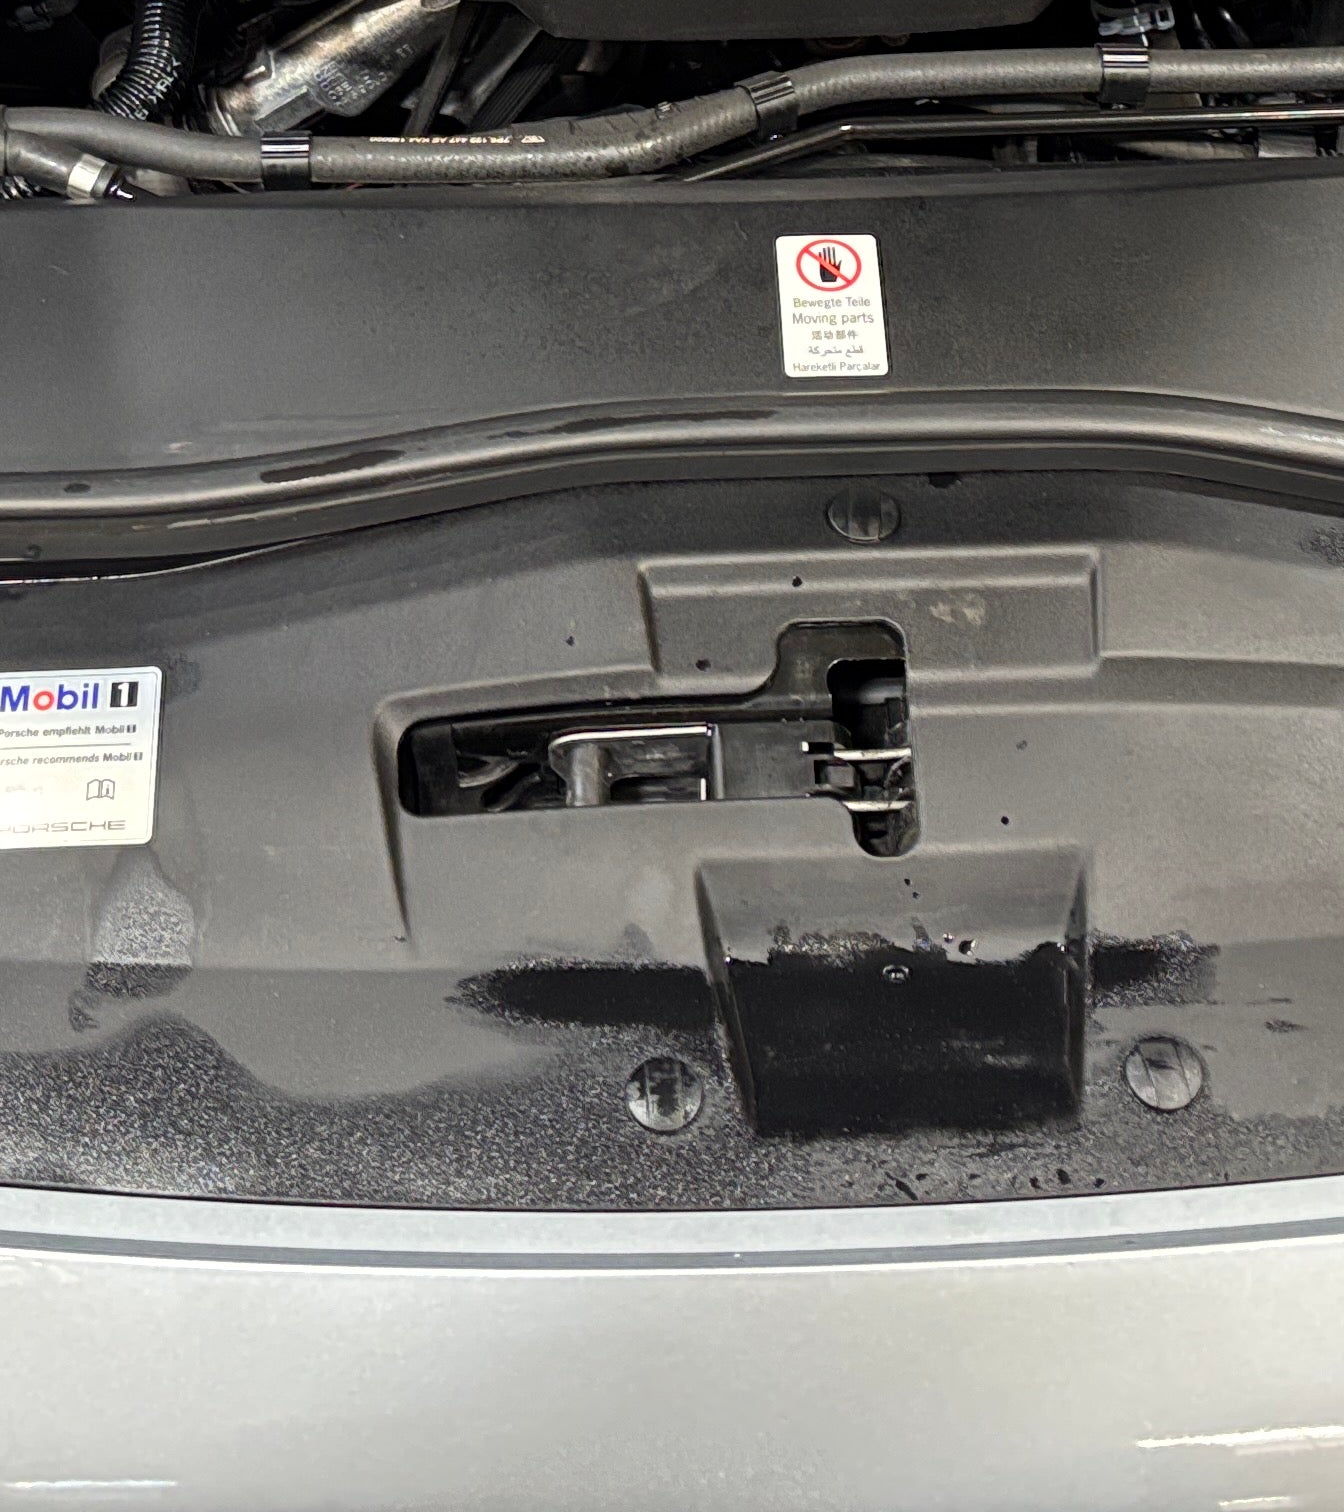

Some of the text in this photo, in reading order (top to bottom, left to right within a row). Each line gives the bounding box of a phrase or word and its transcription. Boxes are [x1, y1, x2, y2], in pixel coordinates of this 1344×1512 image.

[792, 296, 871, 309] Bewegte Teile
[792, 312, 875, 326] Moving parts
[792, 361, 881, 373] Hareketli Parçalar
[0, 682, 100, 712] Mobil
[42, 726, 91, 737] empfiehlt
[94, 724, 125, 735] Mobil
[32, 753, 100, 765] recommends
[102, 752, 132, 762] Mobil
